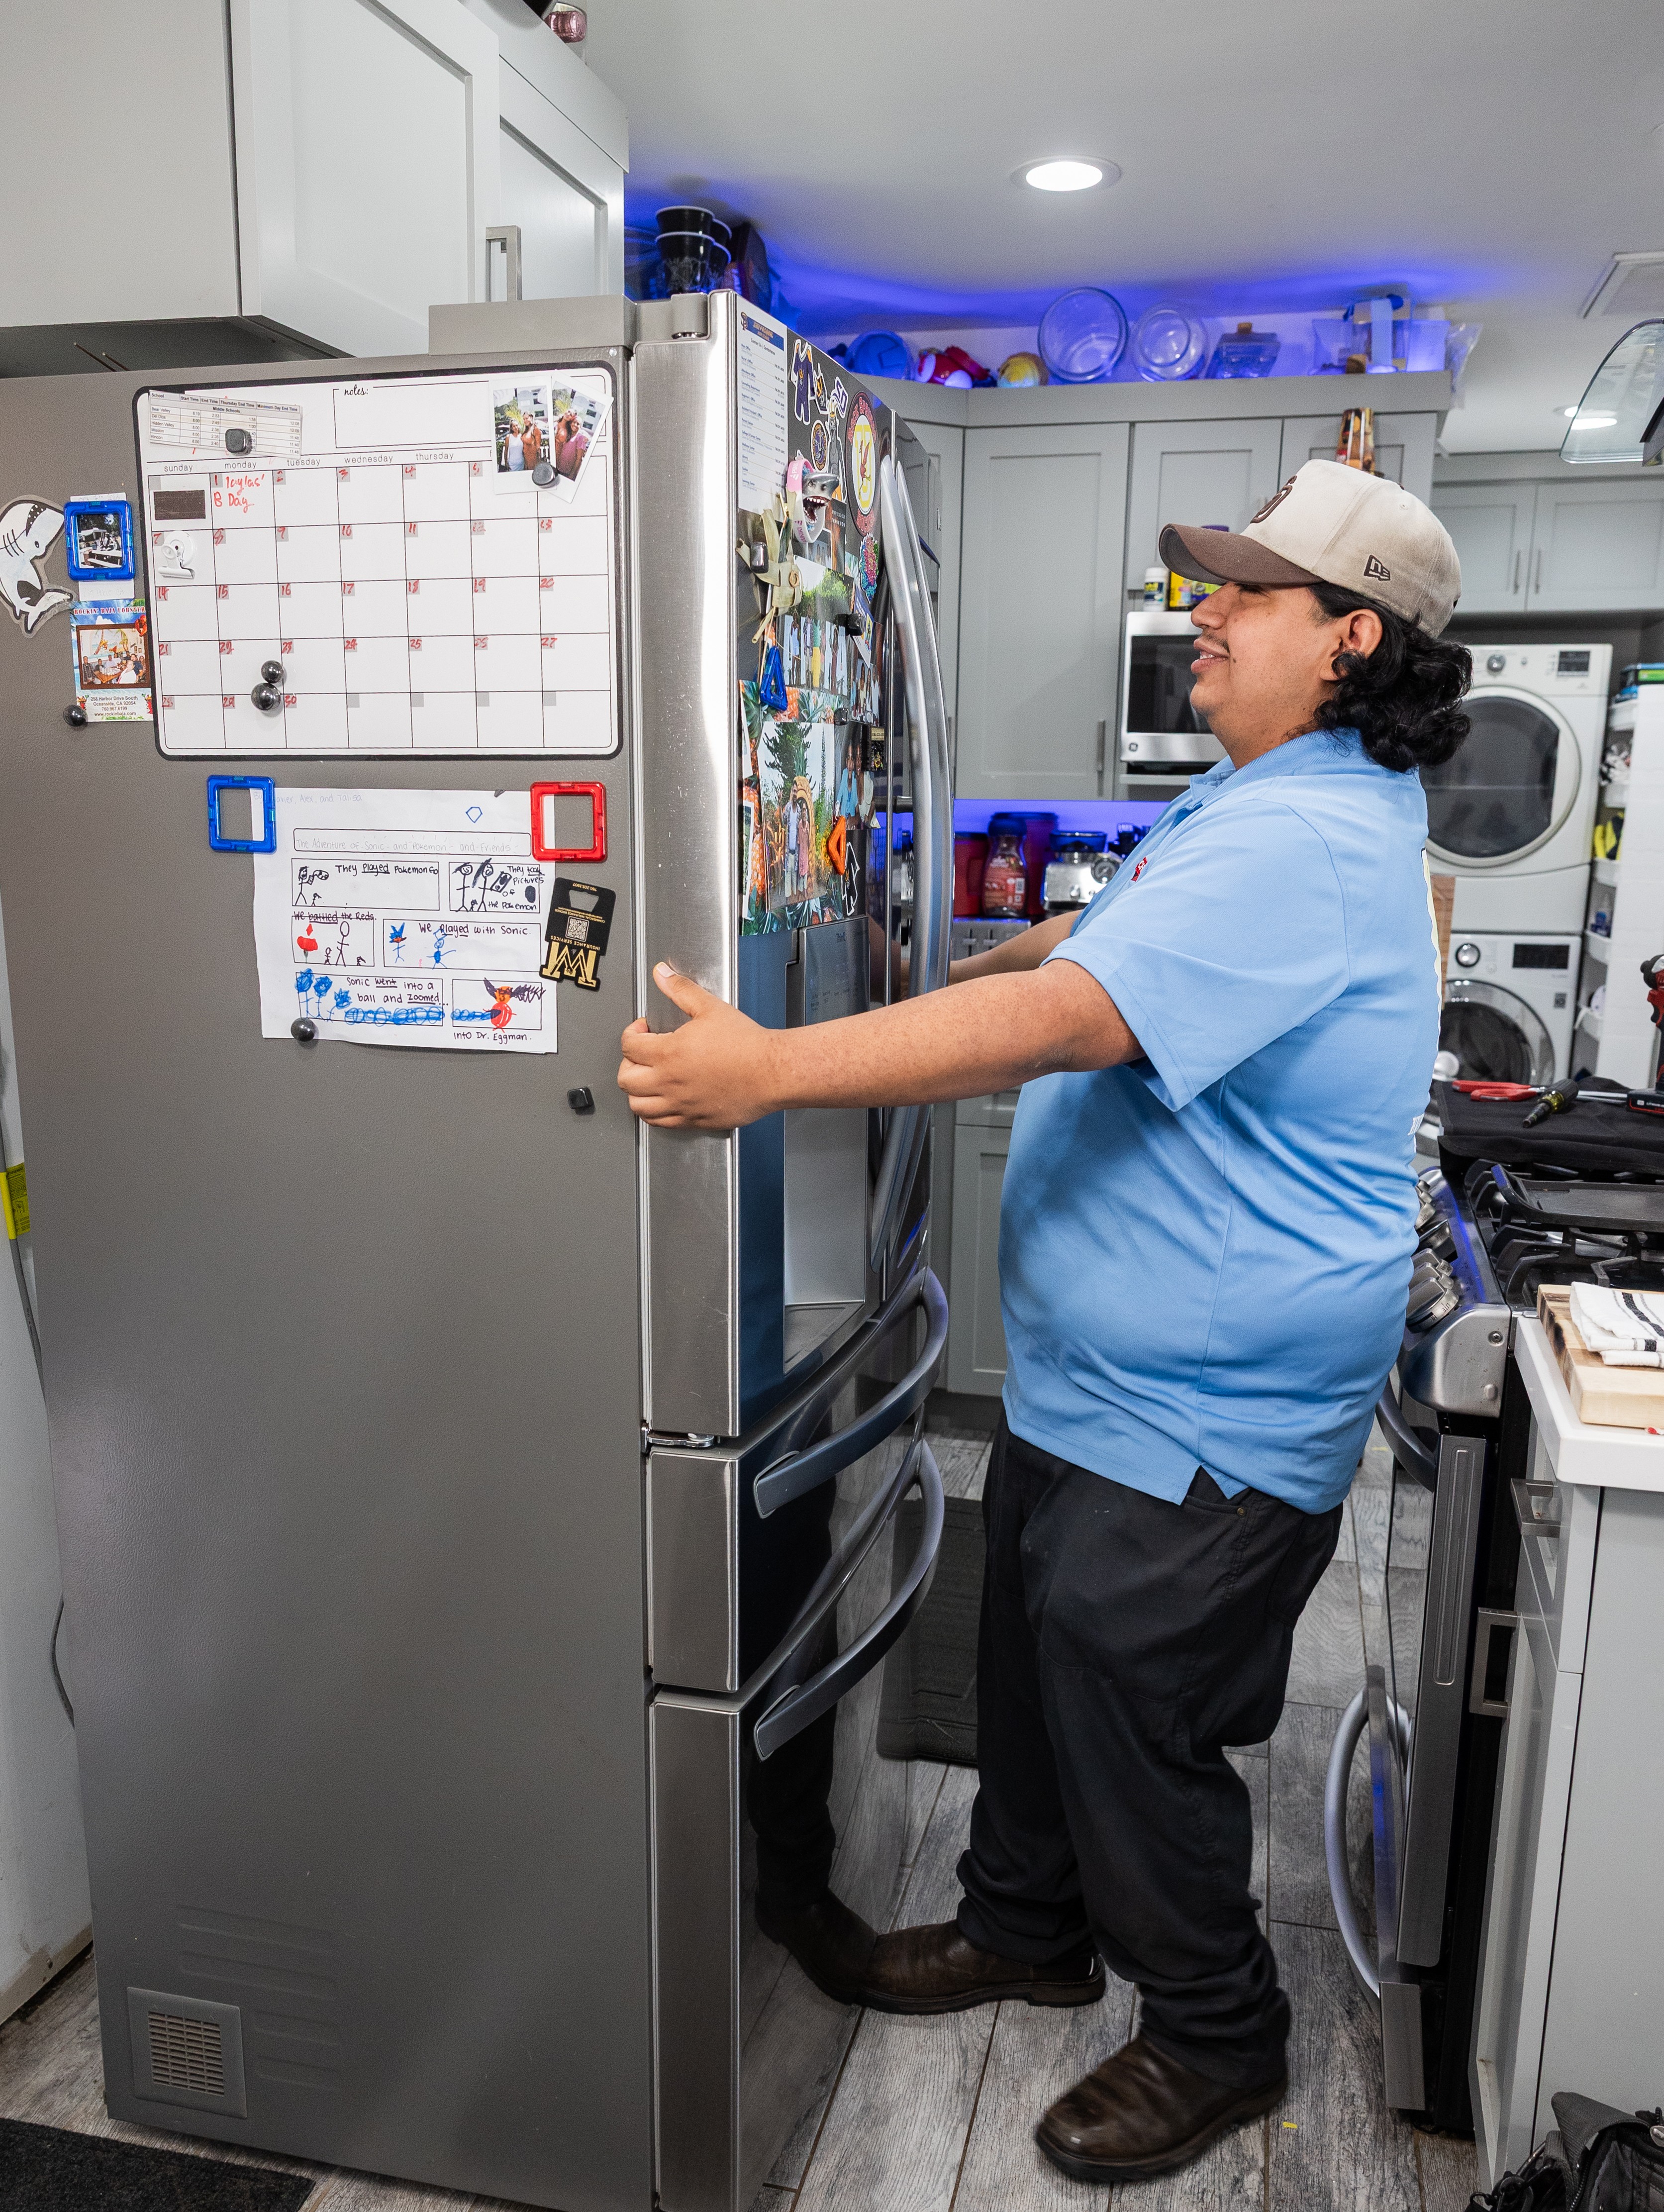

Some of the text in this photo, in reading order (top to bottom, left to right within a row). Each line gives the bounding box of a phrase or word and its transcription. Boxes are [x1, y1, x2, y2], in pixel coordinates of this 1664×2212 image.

[344, 384, 369, 397] notes:
[164, 451, 454, 473] sunday monday tuesday wednesday thursday
[228, 492, 255, 513] Day
[342, 525, 352, 536] 10
[408, 522, 416, 534] 11
[343, 583, 355, 594] 17
[408, 580, 419, 594] 18
[474, 579, 486, 593] 19
[540, 578, 555, 588] 20
[158, 587, 169, 601] 14
[218, 585, 228, 598] 15
[281, 584, 291, 595] 16
[219, 641, 234, 655] 22
[345, 639, 358, 650] 24
[410, 639, 422, 649] 25
[541, 637, 558, 648] 27
[159, 643, 169, 656] 21
[223, 697, 235, 708] 29
[285, 696, 297, 706] 30
[275, 796, 296, 804] avier,
[296, 839, 308, 848] The
[313, 838, 346, 849] Adventure
[393, 842, 408, 851] and
[460, 842, 475, 852] and
[335, 865, 357, 877] They
[507, 866, 524, 877] They
[294, 910, 377, 923] We battled the Reds.
[419, 922, 432, 933] We
[474, 925, 495, 934] with
[550, 935, 600, 951] INSURANCE SERVICES
[347, 977, 370, 987] Sonic
[404, 982, 423, 991] into
[357, 993, 376, 1003] ball
[383, 993, 402, 1004] and
[493, 1033, 532, 1045] Eggman.
